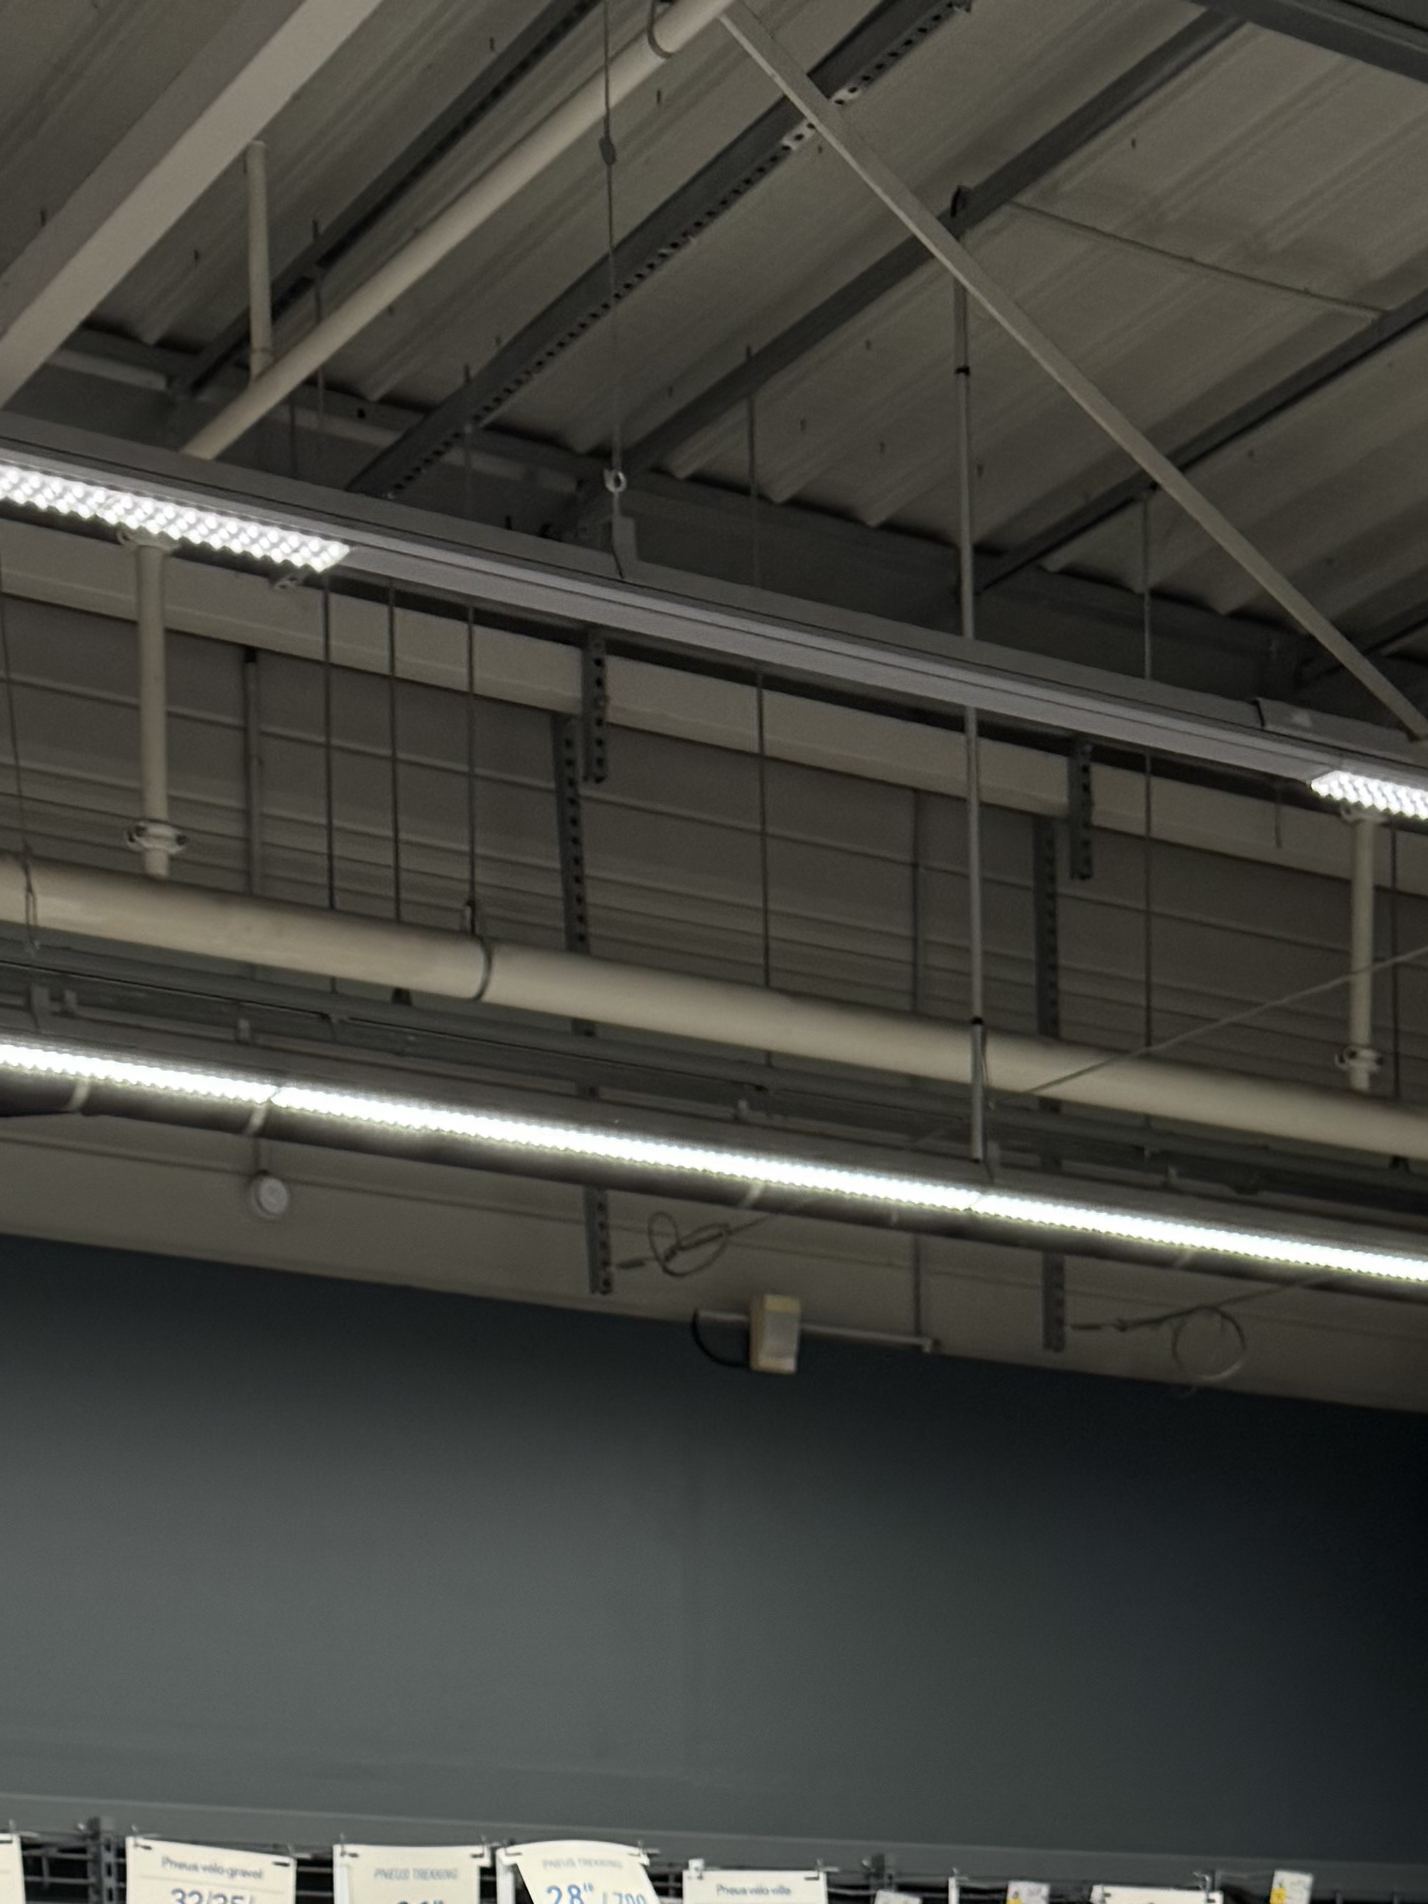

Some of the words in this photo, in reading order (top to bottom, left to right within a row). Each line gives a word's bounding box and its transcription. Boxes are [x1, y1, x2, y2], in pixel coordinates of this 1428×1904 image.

[161, 1856, 199, 1871] Pneus
[225, 1863, 264, 1879] gravel
[542, 1858, 574, 1869] PNEUS
[373, 1868, 409, 1880] PNEUS
[412, 1867, 458, 1880] TREKKING
[716, 1884, 747, 1896] Pneus
[770, 1884, 792, 1895] ville
